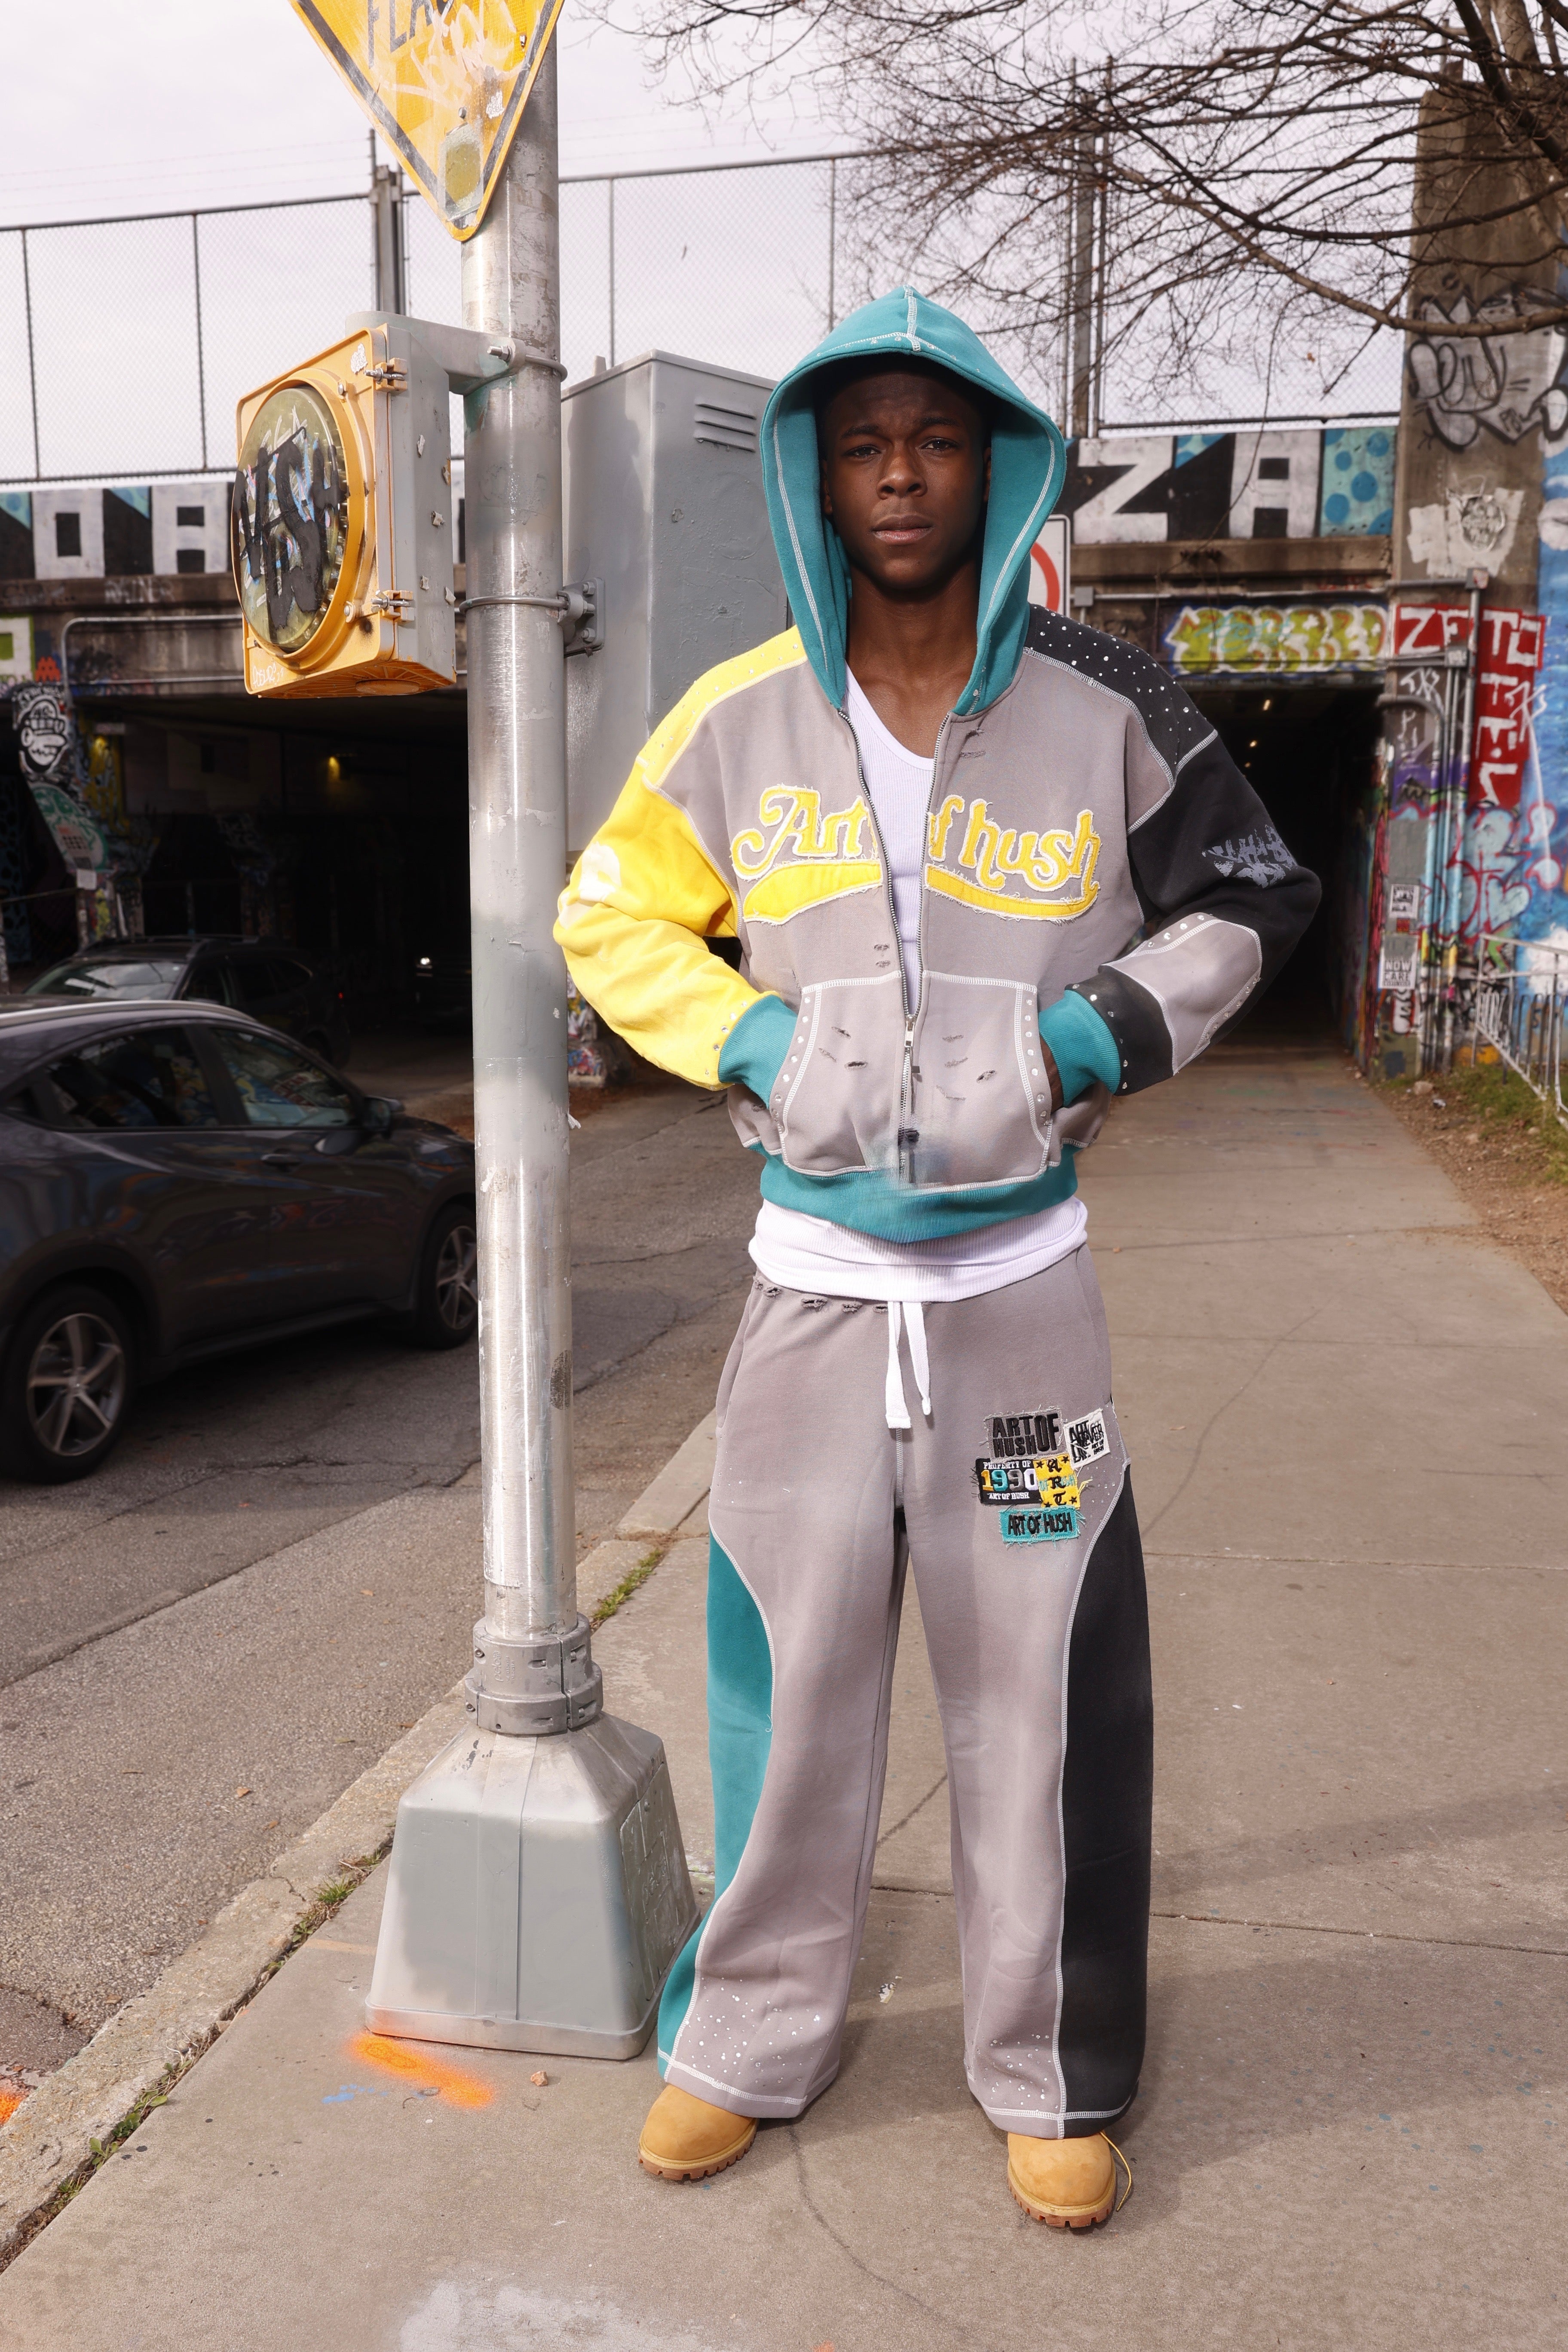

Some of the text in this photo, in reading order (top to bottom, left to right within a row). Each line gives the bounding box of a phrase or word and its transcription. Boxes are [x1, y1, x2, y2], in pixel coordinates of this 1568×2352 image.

[959, 798, 1101, 893] hush
[993, 1413, 1059, 1452] ART OF
[993, 1435, 1037, 1458] HUSH
[981, 1469, 1038, 1491] 1990
[1008, 1512, 1072, 1536] ART OF HUSH
